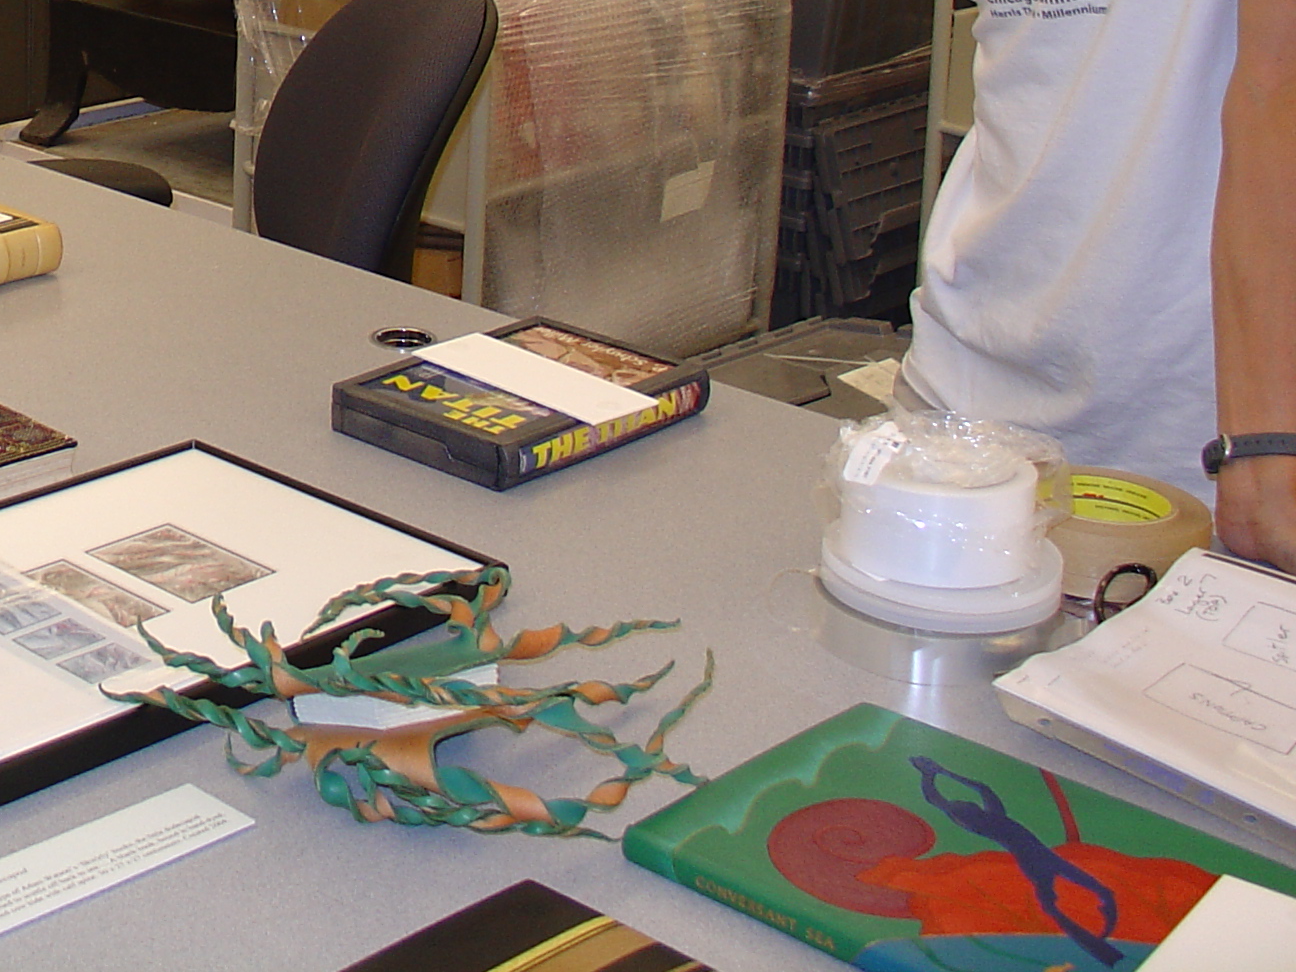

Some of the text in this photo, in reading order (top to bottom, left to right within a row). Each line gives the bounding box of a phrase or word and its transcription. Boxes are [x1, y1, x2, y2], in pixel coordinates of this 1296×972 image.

[381, 374, 527, 430] TITAN
[442, 409, 506, 435] THE
[531, 426, 590, 469] THE
[804, 926, 836, 953] SEA
